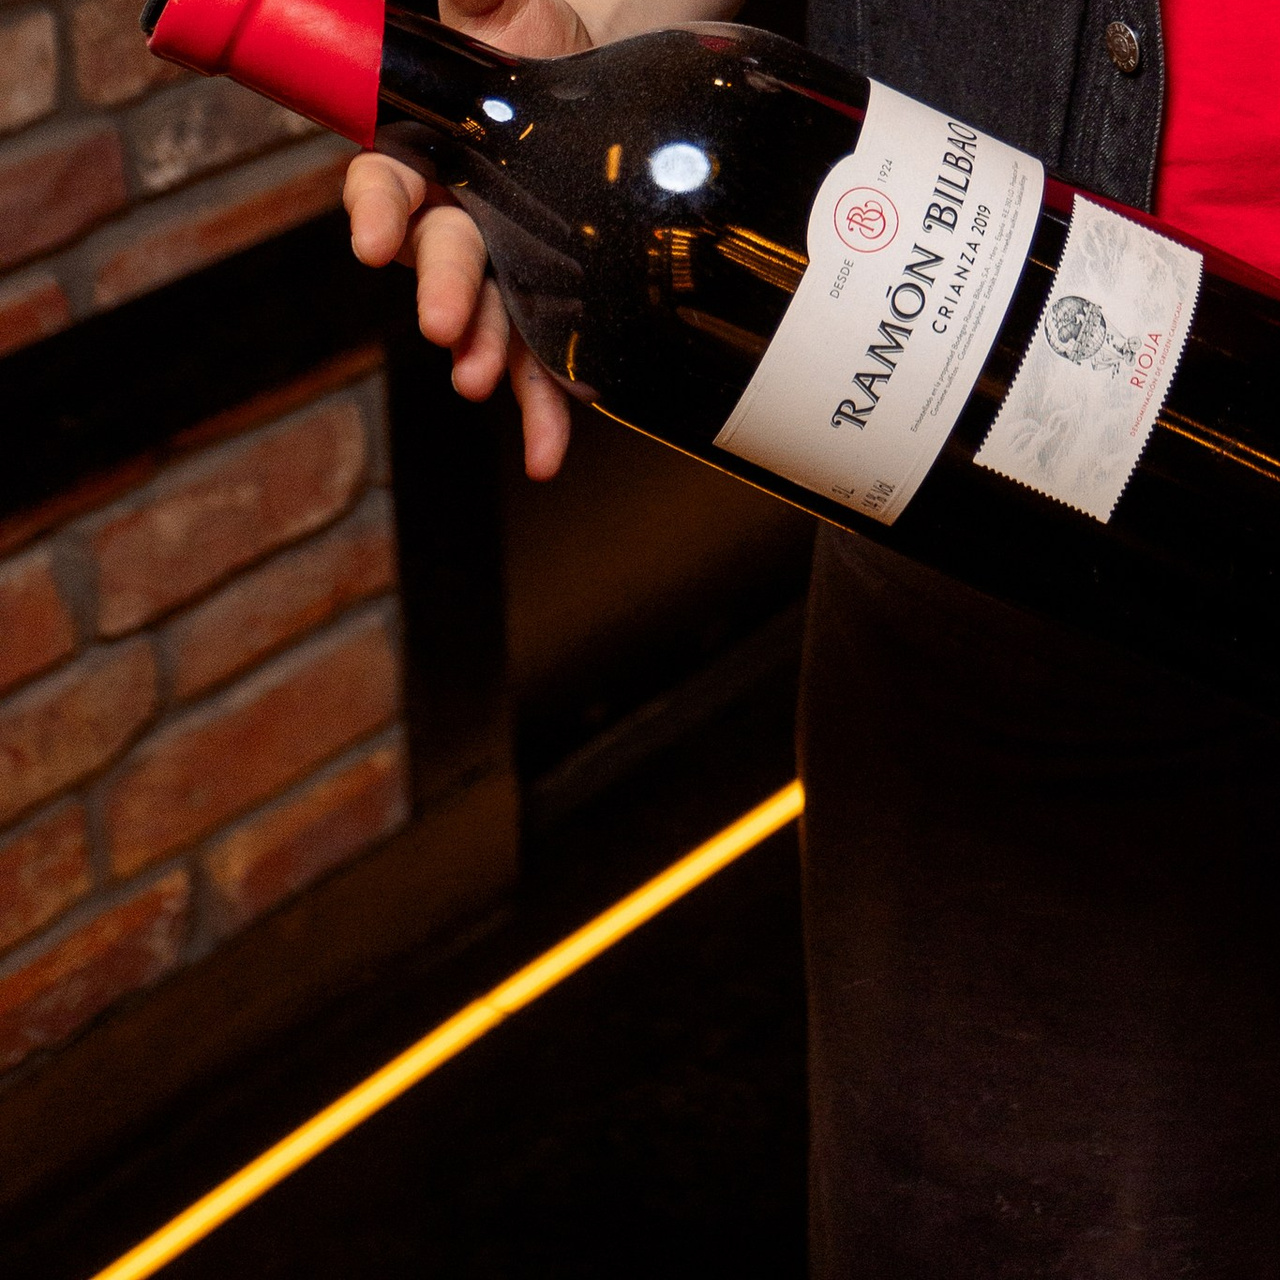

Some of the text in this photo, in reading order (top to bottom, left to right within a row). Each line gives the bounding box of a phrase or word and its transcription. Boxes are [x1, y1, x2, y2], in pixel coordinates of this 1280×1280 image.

[830, 158, 893, 299] DESDE 1924
[922, 122, 978, 235] BILBAO
[932, 204, 991, 334] CRIANZA 2019
[950, 324, 968, 350] Bodegas
[1129, 301, 1184, 437] DENOMINACIÓN DE ORIGEN CALIFICADA
[1130, 332, 1162, 389] RIOJA
